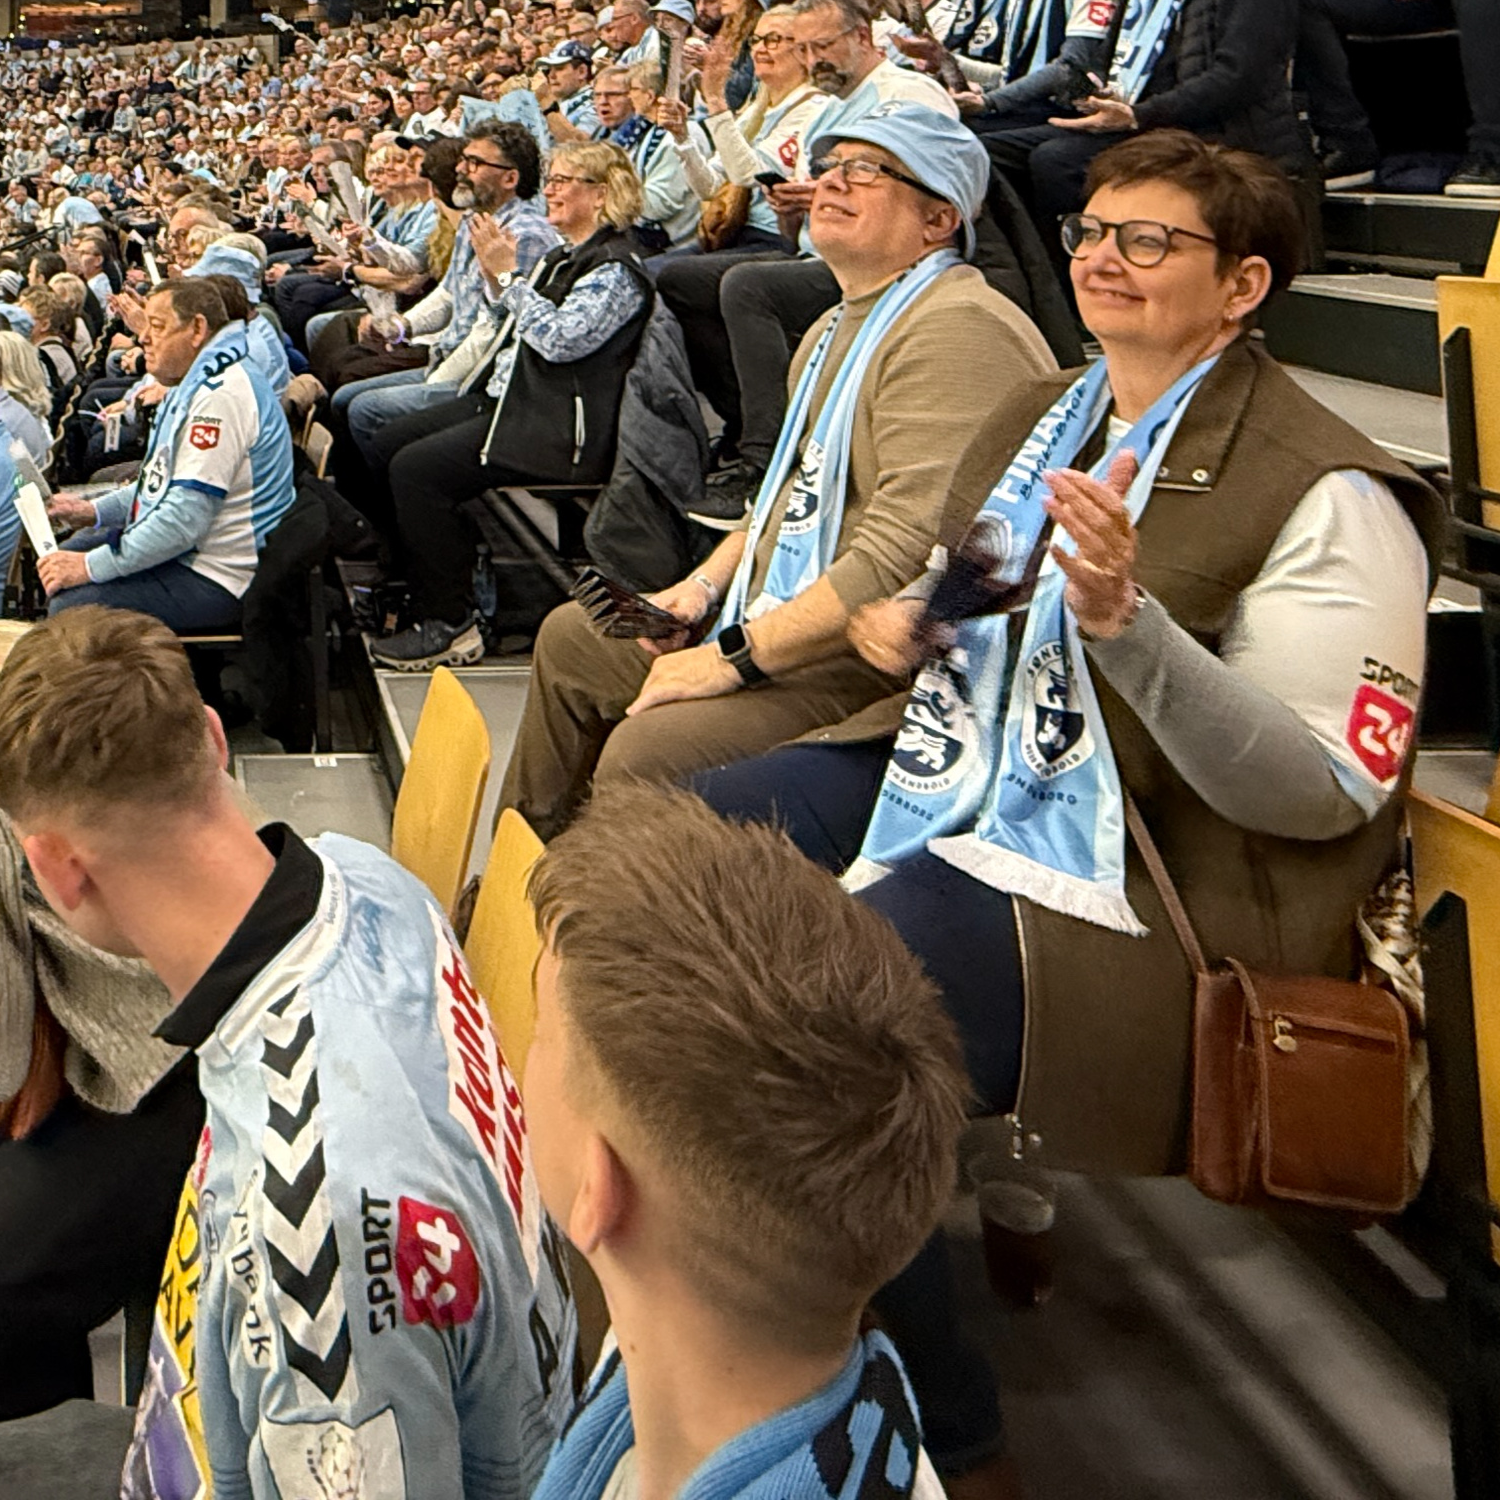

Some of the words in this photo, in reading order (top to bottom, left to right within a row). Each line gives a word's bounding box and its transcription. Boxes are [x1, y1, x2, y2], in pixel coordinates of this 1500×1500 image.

[191, 415, 223, 426] SPORT
[193, 427, 217, 445] 24
[361, 1187, 396, 1334] SPORT
